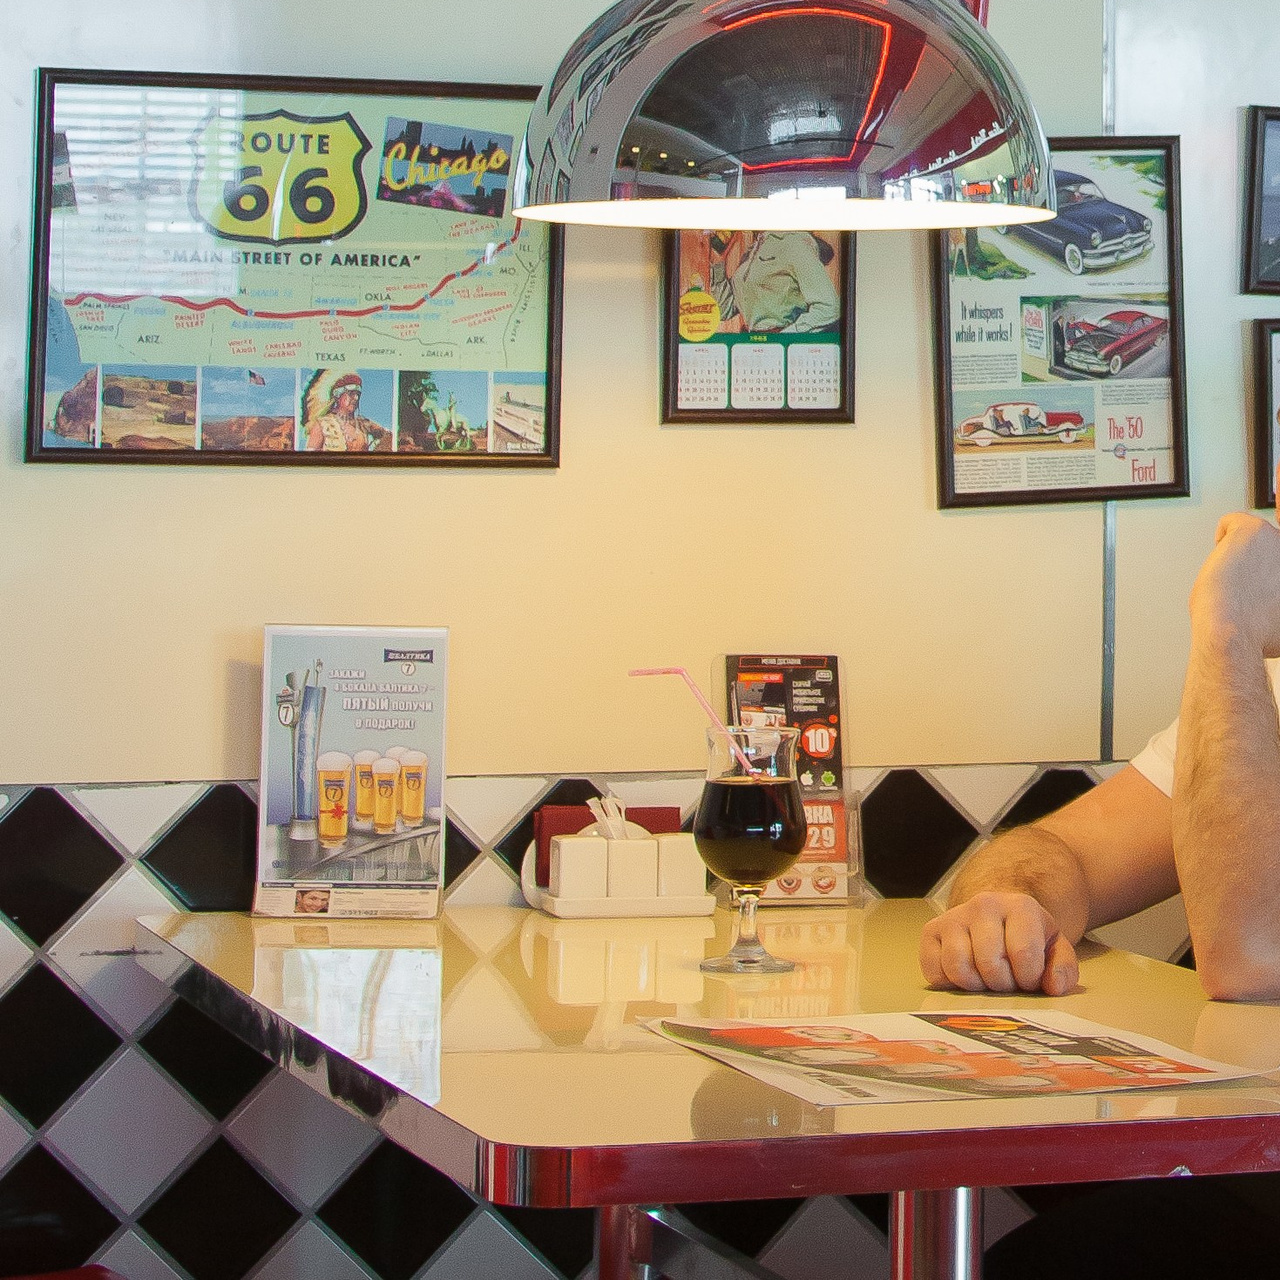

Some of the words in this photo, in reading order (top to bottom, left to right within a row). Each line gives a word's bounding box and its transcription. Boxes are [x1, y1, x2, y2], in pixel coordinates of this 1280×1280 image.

[230, 131, 331, 155] ROUTE
[383, 141, 509, 191] Chicago
[222, 166, 336, 224] 66
[230, 251, 291, 266] STREET
[299, 252, 322, 267] OF
[960, 300, 967, 319] It
[968, 301, 1005, 323] whispers
[955, 322, 977, 344] while
[977, 324, 984, 343] it
[985, 322, 1013, 343] works!
[315, 352, 346, 362] TEXAS
[1107, 417, 1125, 440] The
[1130, 458, 1157, 483] Ford
[343, 696, 391, 712] ПЯТЫЙ
[391, 700, 434, 712] ПОЛУЧИ
[804, 728, 830, 753] 10
